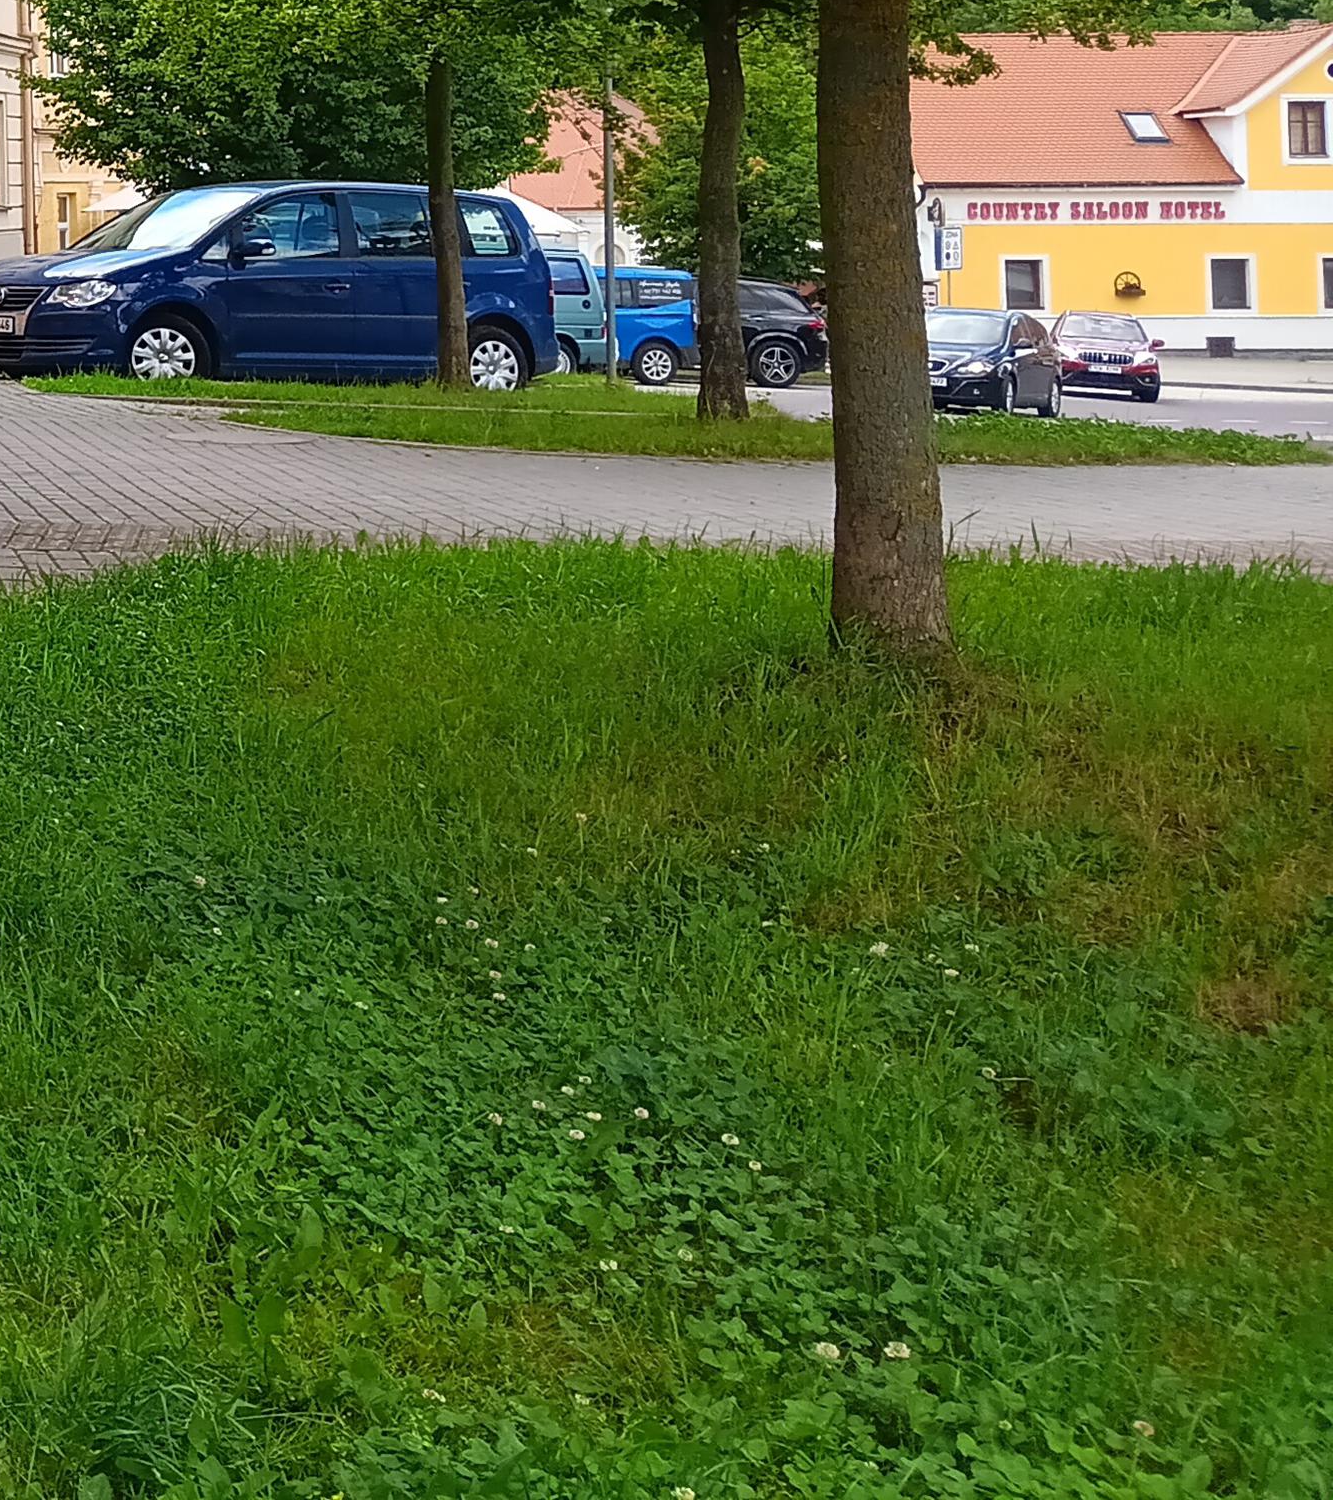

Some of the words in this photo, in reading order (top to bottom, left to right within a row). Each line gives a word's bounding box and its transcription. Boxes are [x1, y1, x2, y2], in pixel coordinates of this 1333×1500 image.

[966, 201, 1061, 221] COUNTRY
[1070, 201, 1149, 221] SALOON
[1159, 201, 1226, 221] HOTEL
